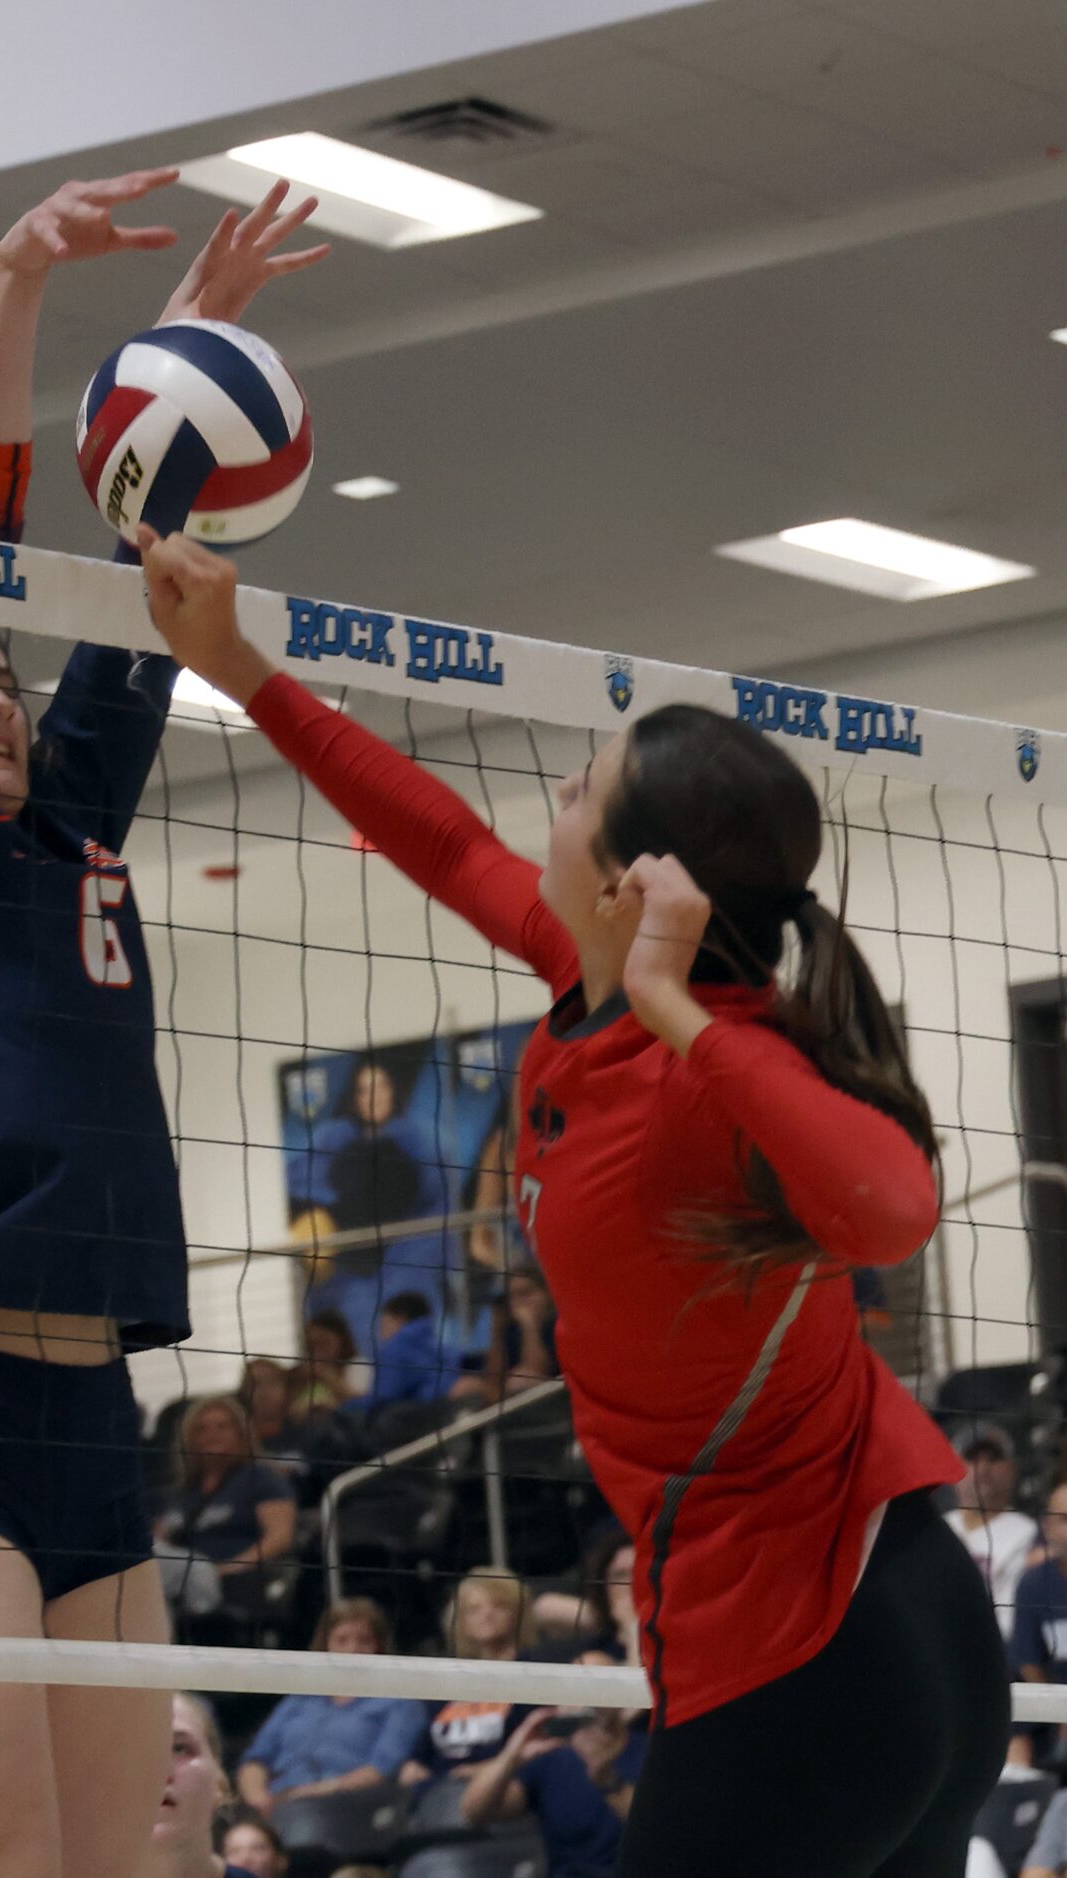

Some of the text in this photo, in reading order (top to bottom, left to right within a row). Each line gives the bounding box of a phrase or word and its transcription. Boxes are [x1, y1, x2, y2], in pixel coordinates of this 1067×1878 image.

[286, 597, 504, 686] ROCK HILL
[732, 676, 922, 757] ROCK HILL
[79, 871, 133, 989] 6
